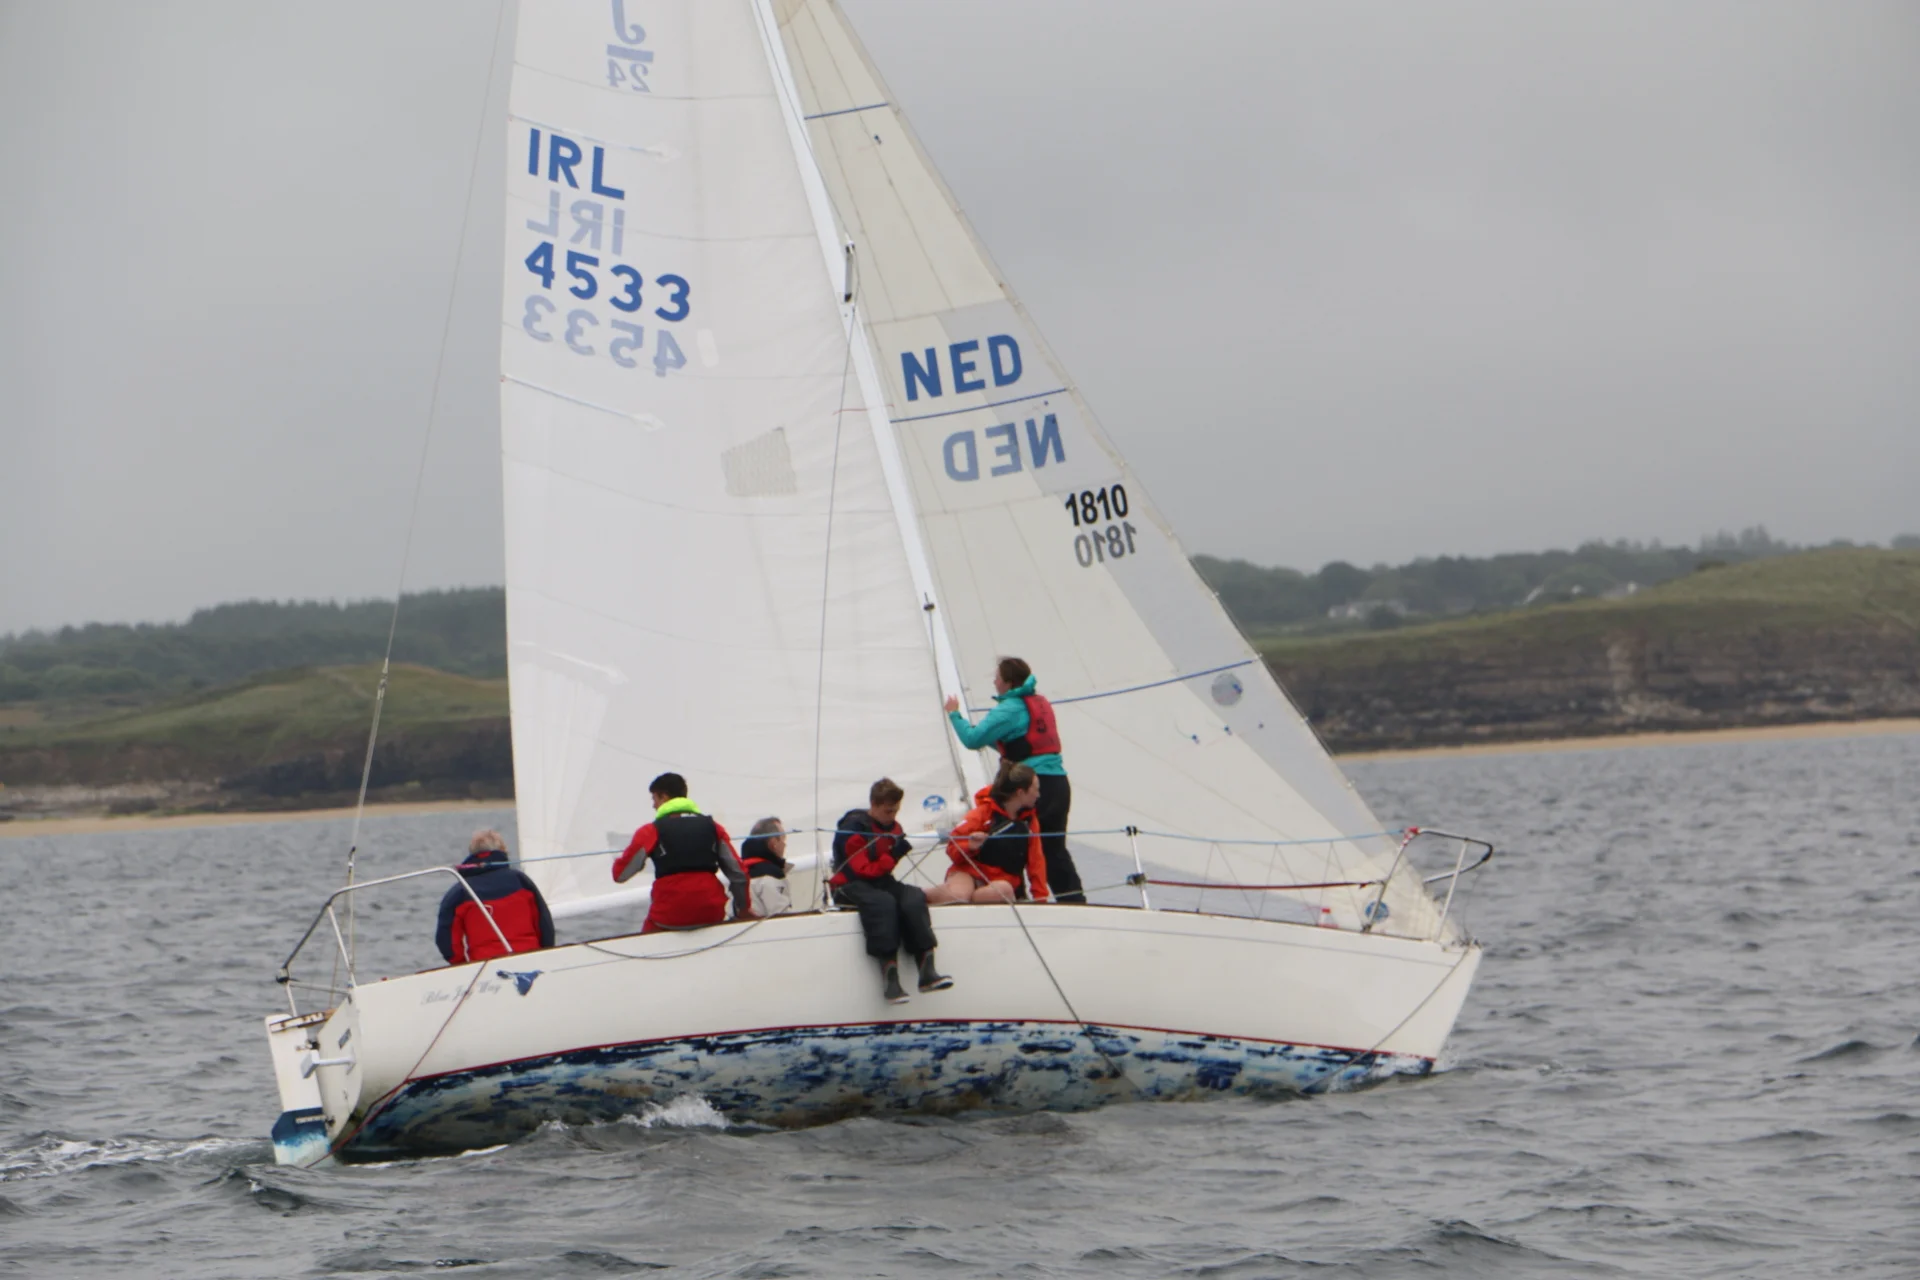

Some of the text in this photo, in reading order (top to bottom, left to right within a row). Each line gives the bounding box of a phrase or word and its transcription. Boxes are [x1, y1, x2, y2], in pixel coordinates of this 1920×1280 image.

[528, 128, 625, 200] IRL
[524, 241, 690, 322] 4533
[901, 334, 1022, 402] NED
[1065, 484, 1128, 526] 1810
